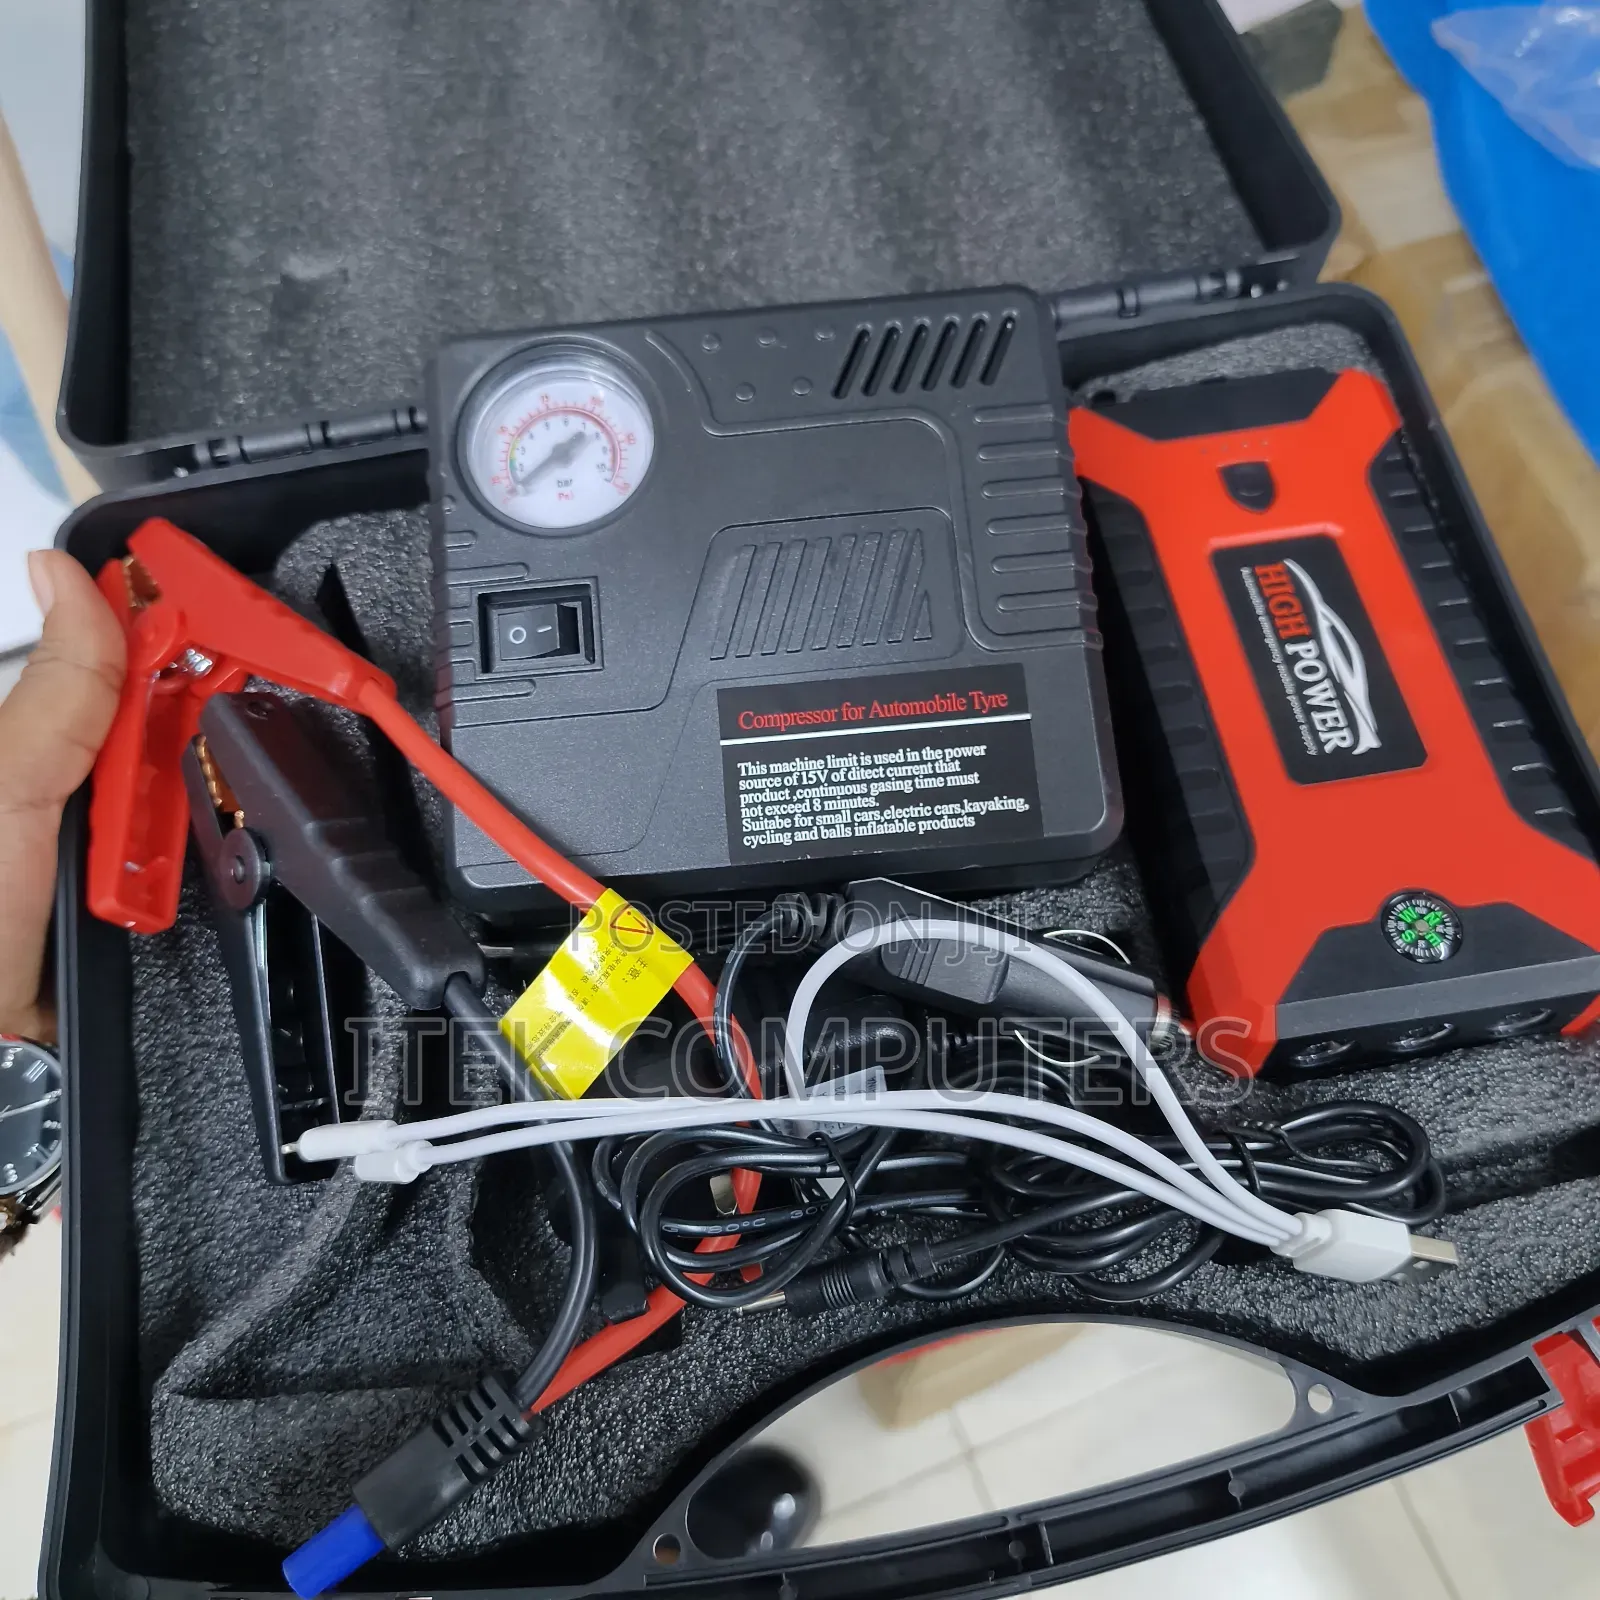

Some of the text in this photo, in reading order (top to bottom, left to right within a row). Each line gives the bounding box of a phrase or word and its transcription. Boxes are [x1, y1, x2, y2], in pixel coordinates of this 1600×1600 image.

[556, 478, 574, 488] bar
[1239, 566, 1317, 755] Automobile emergency mobile power supply
[1254, 562, 1355, 755] HIGH POWER
[737, 690, 1007, 731] Compressor for Automobile Tyre
[736, 744, 986, 776] This machine limit is used in the power
[738, 759, 961, 790] source of 15V of ditect current that
[739, 787, 790, 807] product
[869, 777, 913, 796] gasing
[913, 775, 944, 789] time
[945, 772, 980, 786] must
[740, 793, 879, 818] not exceed 8 minutes.
[741, 815, 791, 832] Suitabe
[793, 814, 813, 827] for
[815, 809, 852, 826] small
[742, 813, 975, 848] cycling and balls inflatable products
